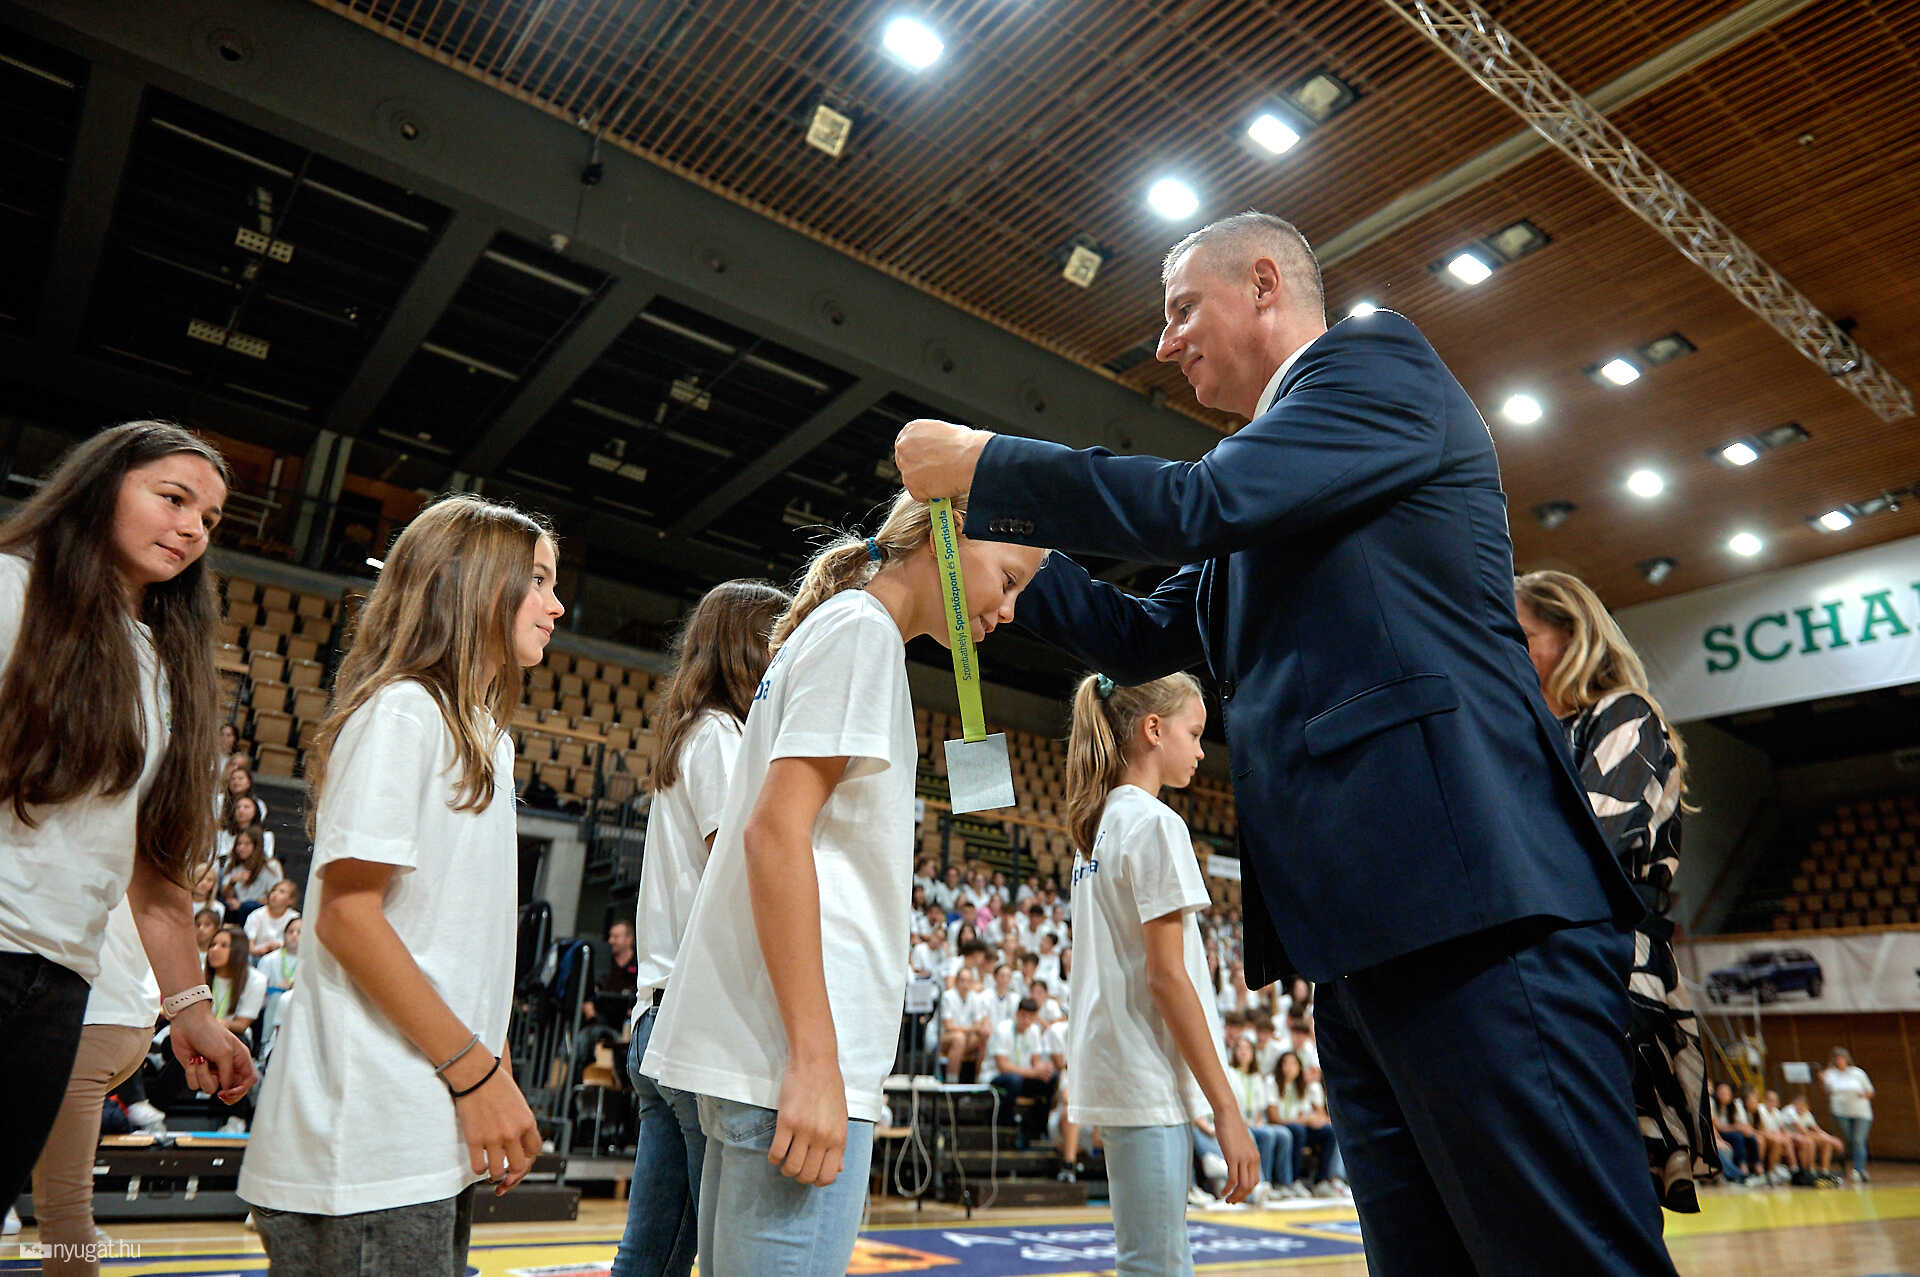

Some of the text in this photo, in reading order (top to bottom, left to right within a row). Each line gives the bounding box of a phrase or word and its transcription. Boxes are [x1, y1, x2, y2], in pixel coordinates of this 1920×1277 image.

[939, 510, 972, 681] Szombathelyi Sportközpont és Sportiskola
[1703, 582, 1920, 675] SCHA
